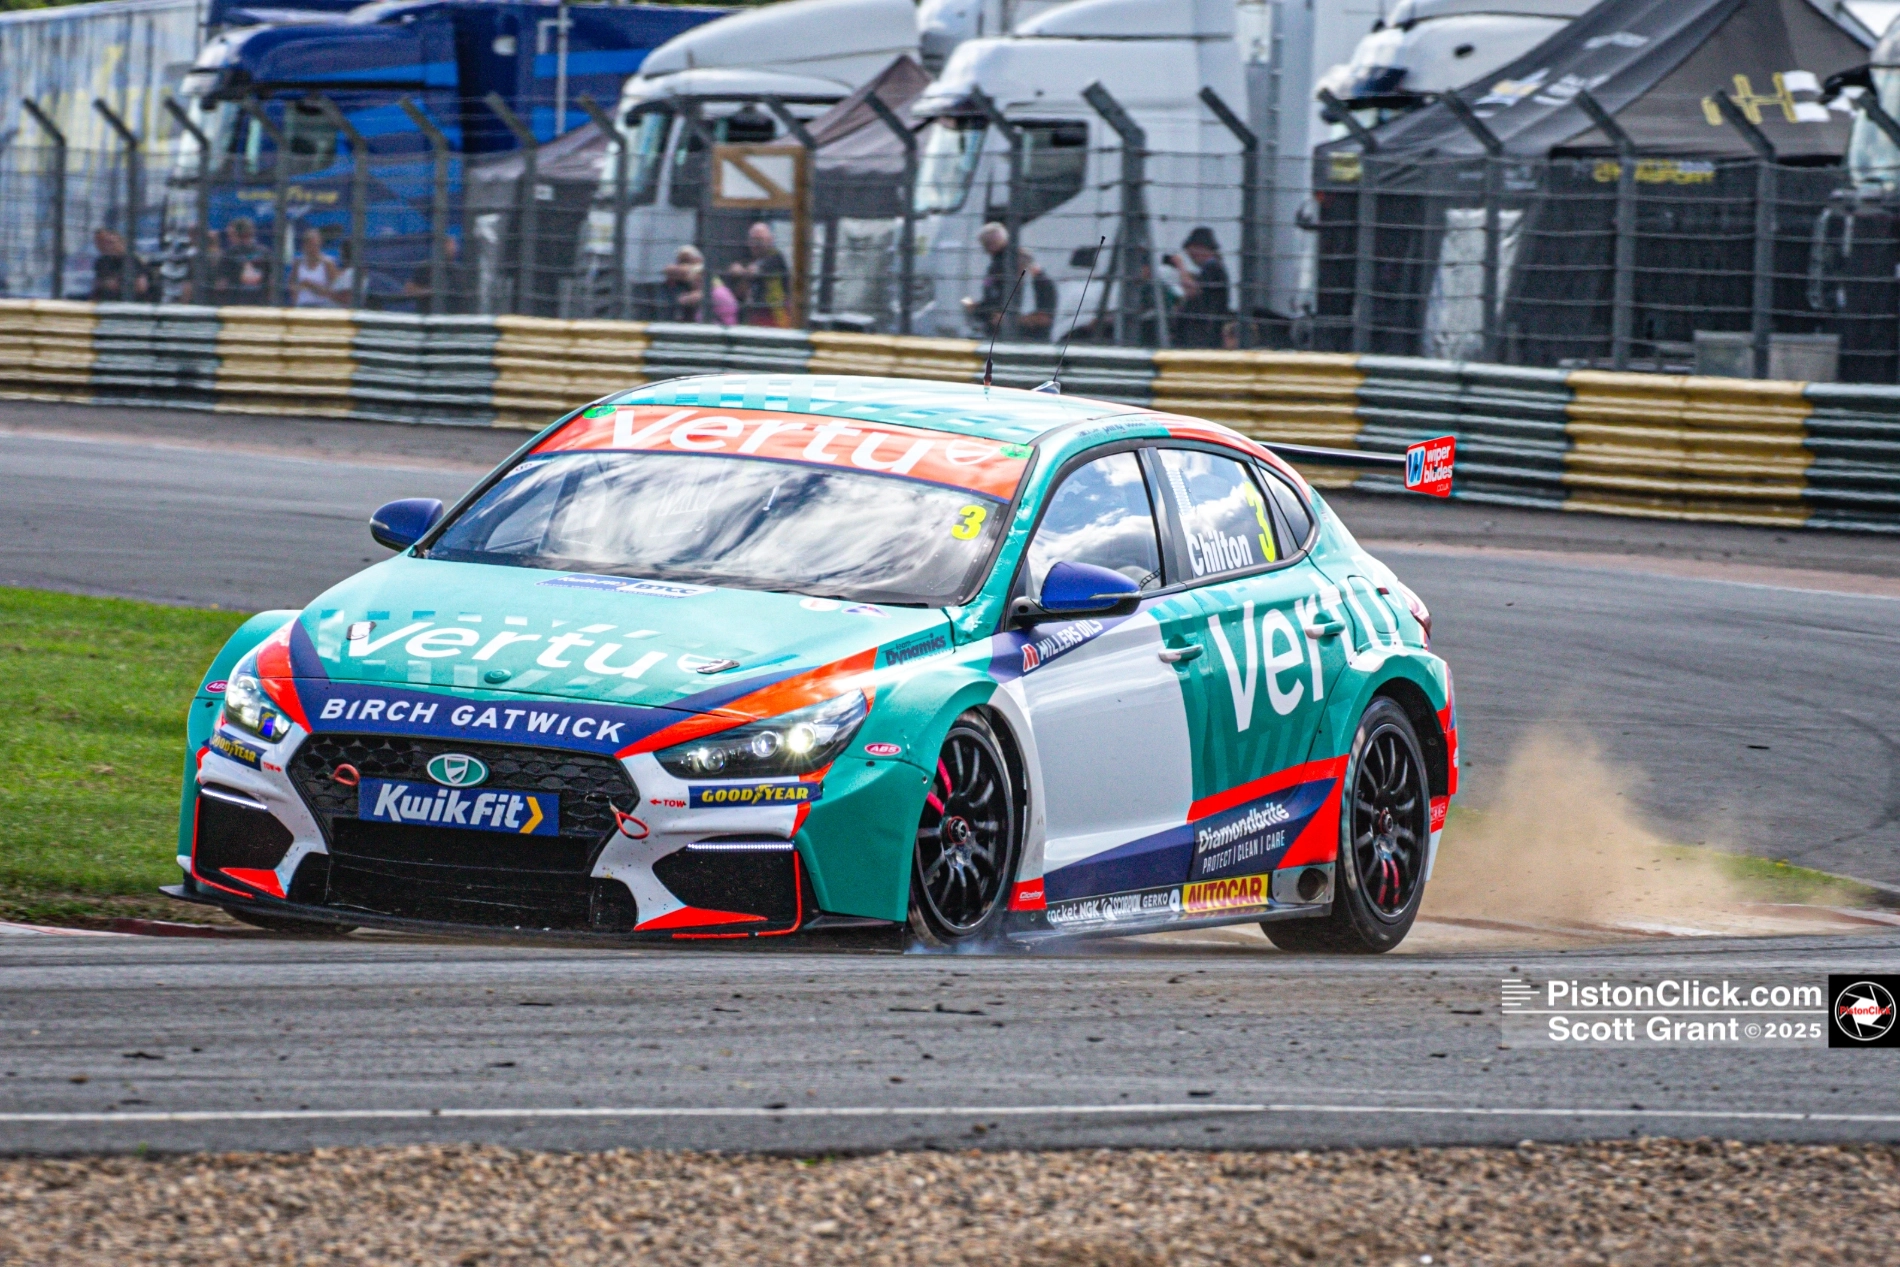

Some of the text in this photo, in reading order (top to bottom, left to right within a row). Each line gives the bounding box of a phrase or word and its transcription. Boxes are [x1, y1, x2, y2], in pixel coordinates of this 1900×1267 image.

[611, 409, 934, 475] Vertu
[1427, 443, 1451, 466] wiper
[1423, 461, 1453, 483] blades
[950, 505, 986, 541] 3
[1244, 481, 1276, 563] 3
[1187, 530, 1254, 576] Chilton
[348, 621, 668, 680] Vertu
[885, 632, 947, 667] Dynamics
[1036, 625, 1083, 661] MILLERS
[1075, 618, 1103, 637] OILS
[319, 698, 626, 744] BIRCH GATWICK
[211, 733, 256, 763] GOODYEAR
[870, 745, 897, 753] ABS
[663, 799, 687, 808] TOW
[702, 784, 809, 804] GOODYEAR
[1198, 801, 1290, 854] Diamondbrite
[1202, 830, 1286, 875] PROTECT CLEAN CARE
[1079, 899, 1100, 920] NGK
[1142, 892, 1168, 908] GERKO
[1188, 876, 1263, 911] AUTOCAR
